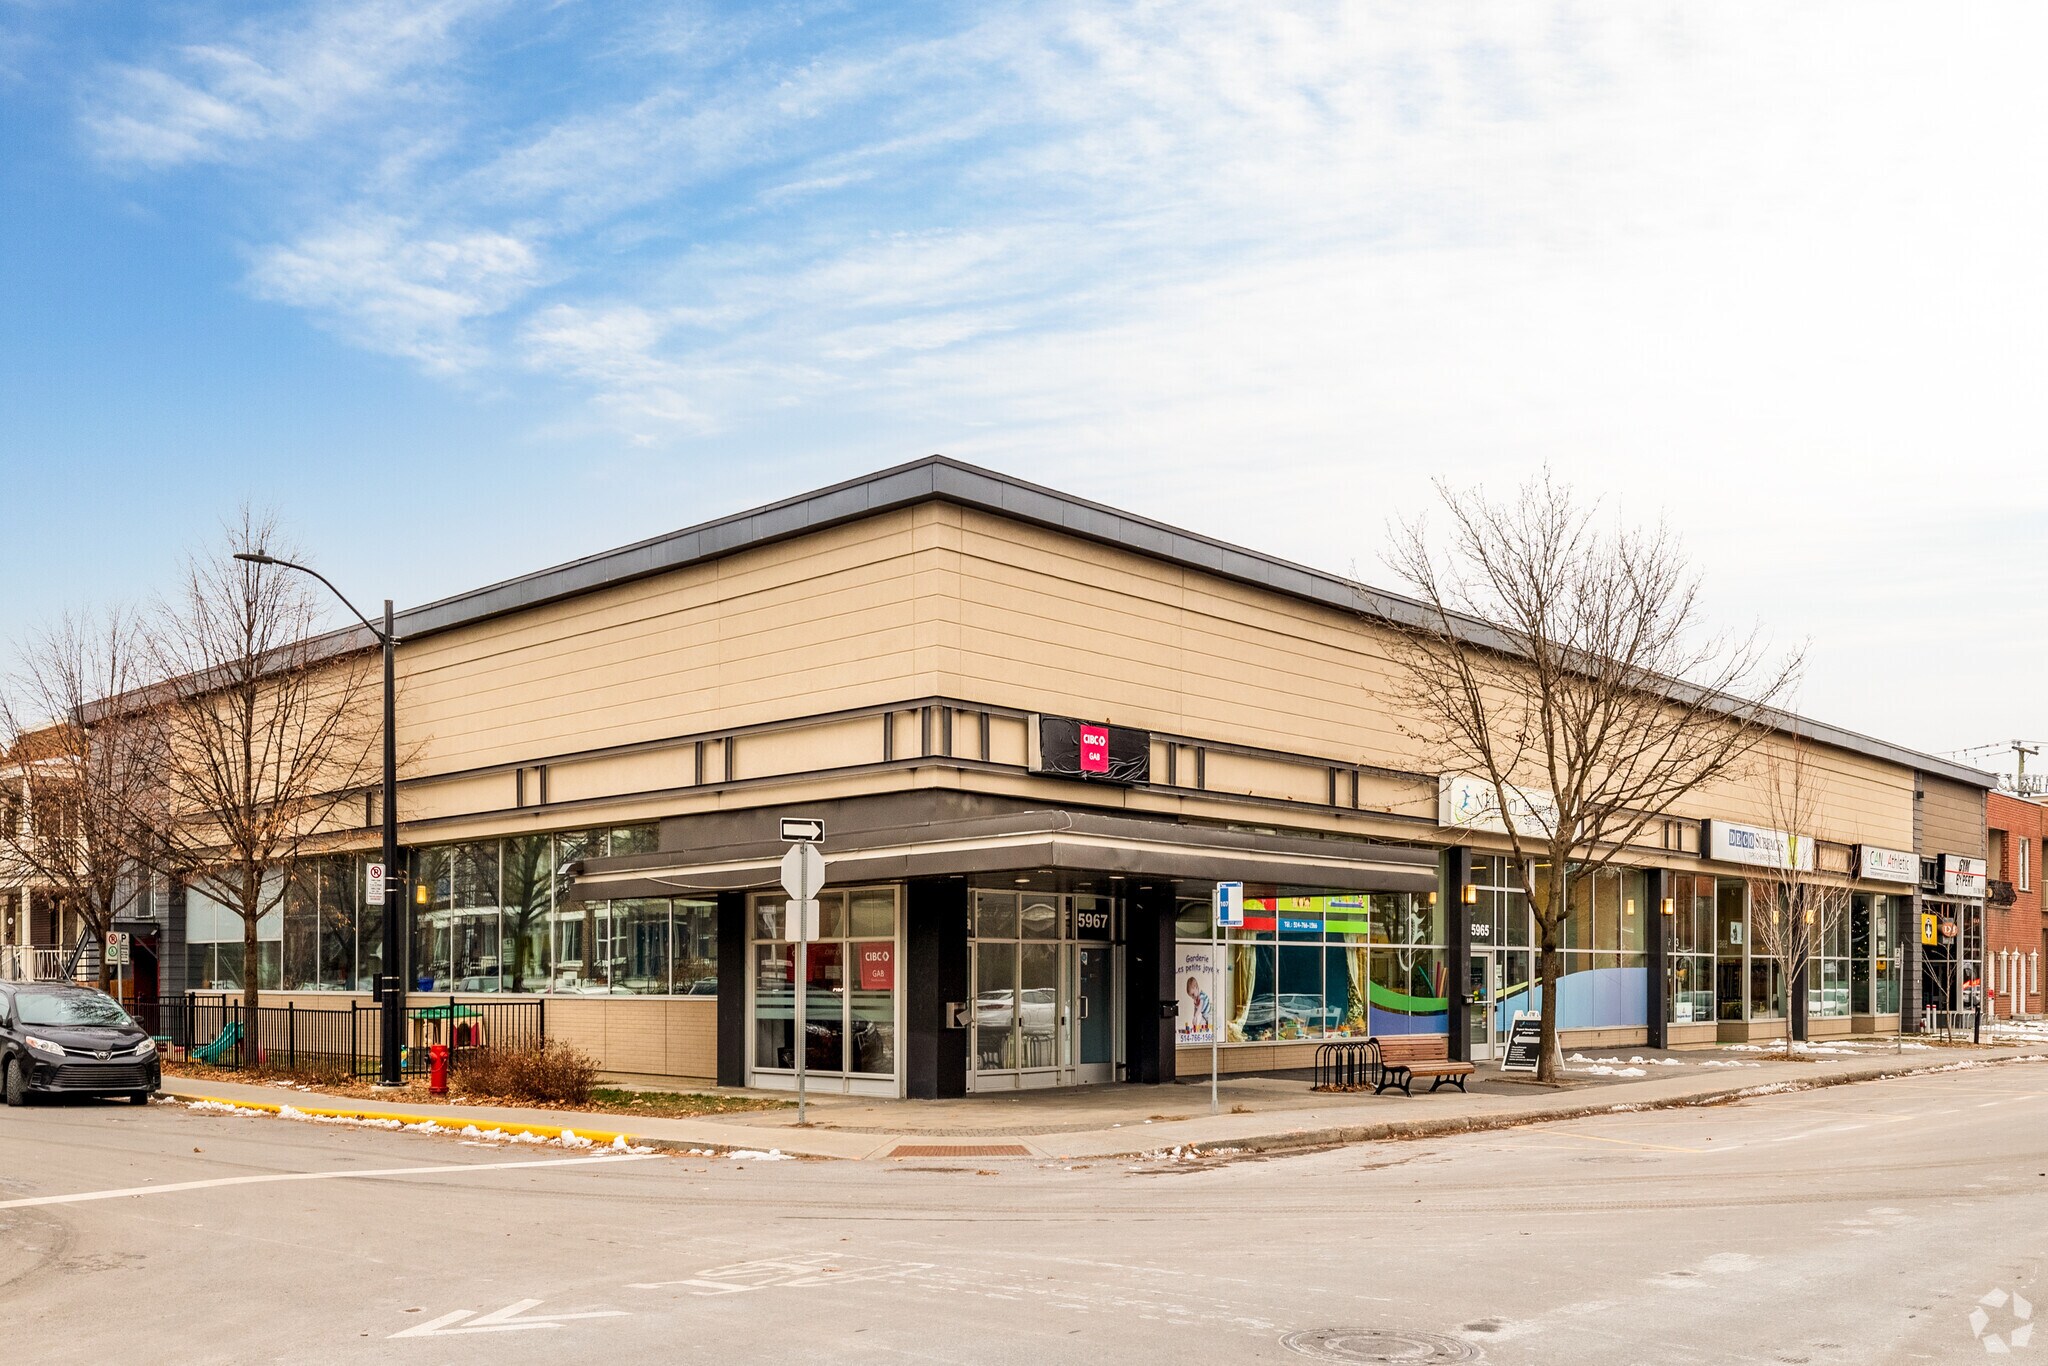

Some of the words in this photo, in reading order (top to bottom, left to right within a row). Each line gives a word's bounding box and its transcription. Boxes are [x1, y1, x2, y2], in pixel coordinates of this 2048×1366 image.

[1083, 734, 1099, 746] CIBC
[1089, 752, 1100, 761] GAB
[1958, 858, 1971, 873] GYM
[1078, 912, 1108, 928] 5967
[1471, 923, 1490, 936] 5965
[865, 951, 882, 962] CIBC
[1185, 953, 1209, 963] Garderie
[872, 969, 885, 978] GAB
[1185, 963, 1201, 974] petits
[1203, 964, 1220, 974] joyex
